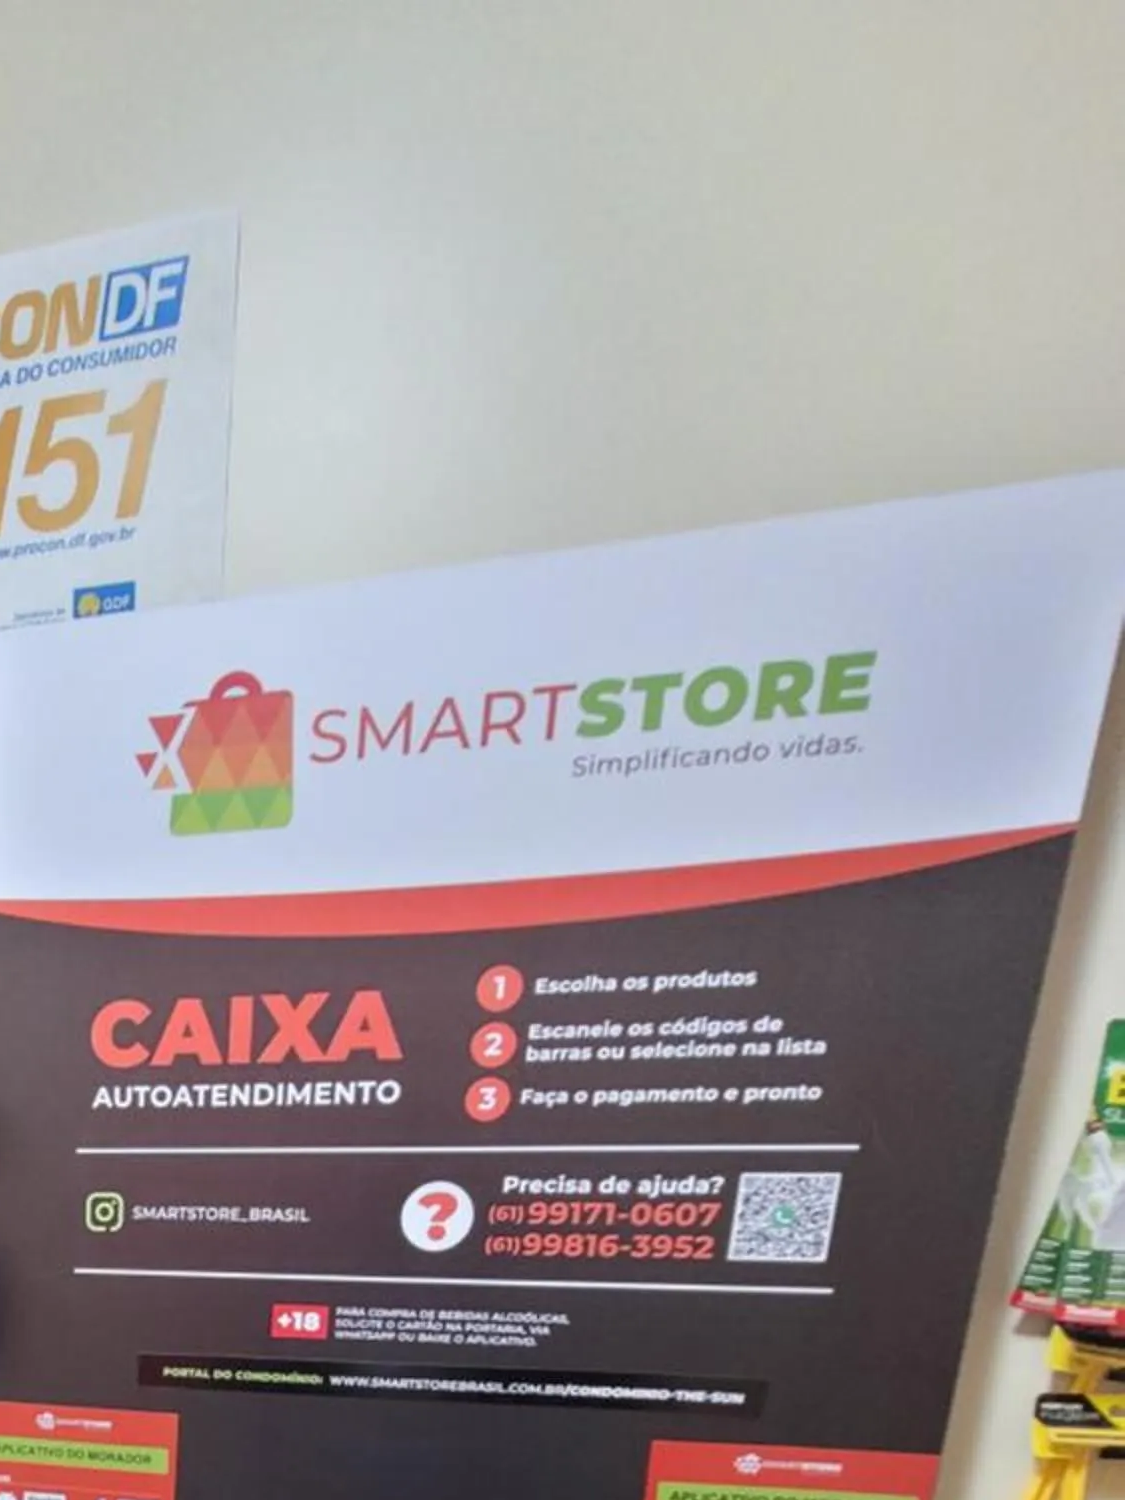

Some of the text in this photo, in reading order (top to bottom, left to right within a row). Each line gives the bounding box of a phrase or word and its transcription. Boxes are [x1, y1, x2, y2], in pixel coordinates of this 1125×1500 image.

[16, 366, 42, 387] DO
[47, 337, 177, 378] CONSUMIDOR
[309, 650, 877, 763] SMARTSTORE
[572, 733, 864, 779] Simplificando vidas.
[494, 970, 757, 999] 1 Escolha os produtos
[89, 990, 403, 1069] CAIXA
[483, 1033, 502, 1057] 2
[628, 1023, 654, 1037] os
[659, 1016, 747, 1039] códigos
[753, 1016, 783, 1034] de
[526, 1037, 827, 1062] barras ou selecione na lista
[92, 1079, 402, 1110] AUTOATENDIMENTO
[477, 1084, 823, 1110] 3 Faça o pagamento e pronto
[503, 1174, 726, 1200] Precisa de ajuda?
[132, 1205, 311, 1223] SMARTSTORE_BRASIL
[335, 1307, 365, 1317] PARA
[419, 1309, 435, 1320] DE
[162, 1365, 210, 1380] PORTAL
[213, 1368, 232, 1380] DO
